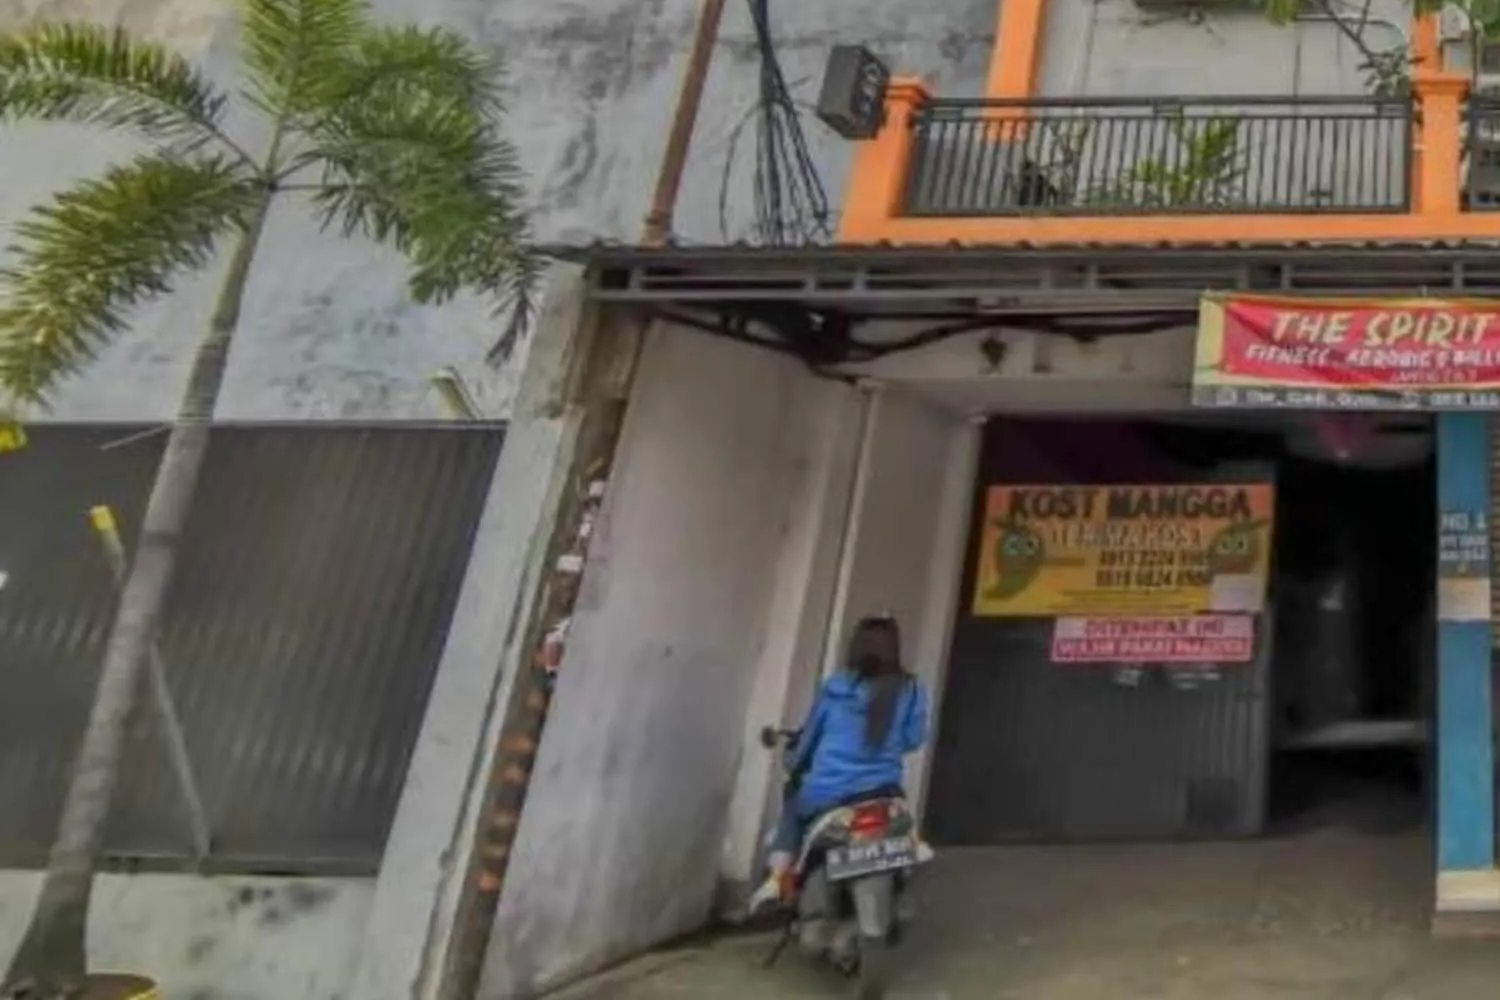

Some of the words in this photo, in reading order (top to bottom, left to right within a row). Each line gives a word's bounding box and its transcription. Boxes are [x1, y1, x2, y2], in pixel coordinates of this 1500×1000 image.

[1271, 310, 1347, 342] THE
[1364, 310, 1495, 347] SPIRIT
[1010, 488, 1097, 520] KOST
[1108, 486, 1252, 518] MANGGA
